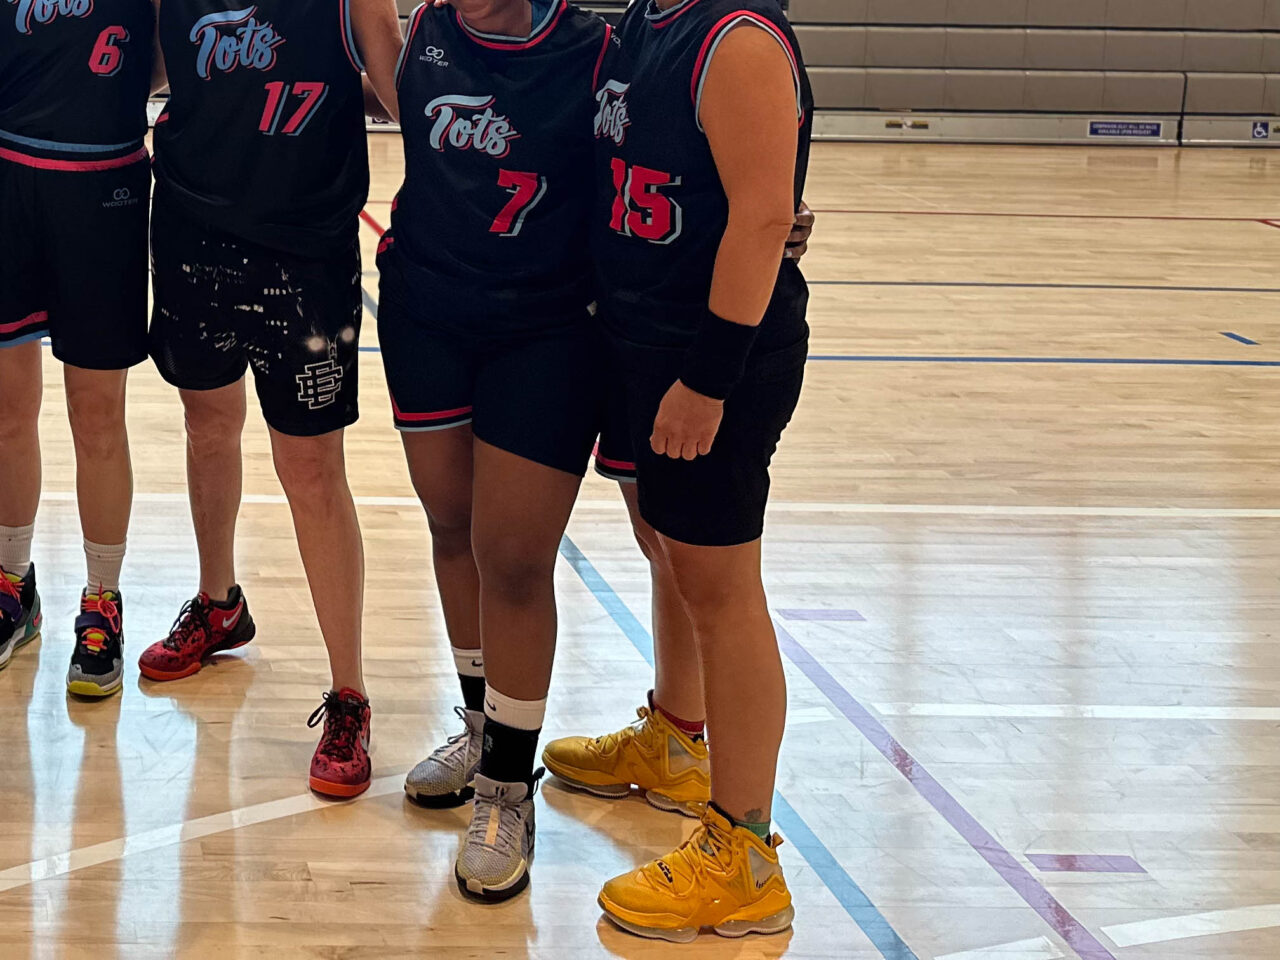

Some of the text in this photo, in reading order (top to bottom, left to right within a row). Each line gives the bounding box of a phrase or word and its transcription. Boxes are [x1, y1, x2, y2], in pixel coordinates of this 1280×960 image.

[88, 25, 130, 77] 6
[189, 5, 287, 81] Tots
[258, 81, 330, 137] 17
[424, 94, 522, 159] Tots
[593, 79, 632, 147] Tots
[488, 168, 548, 237] 7
[609, 157, 683, 245] 15
